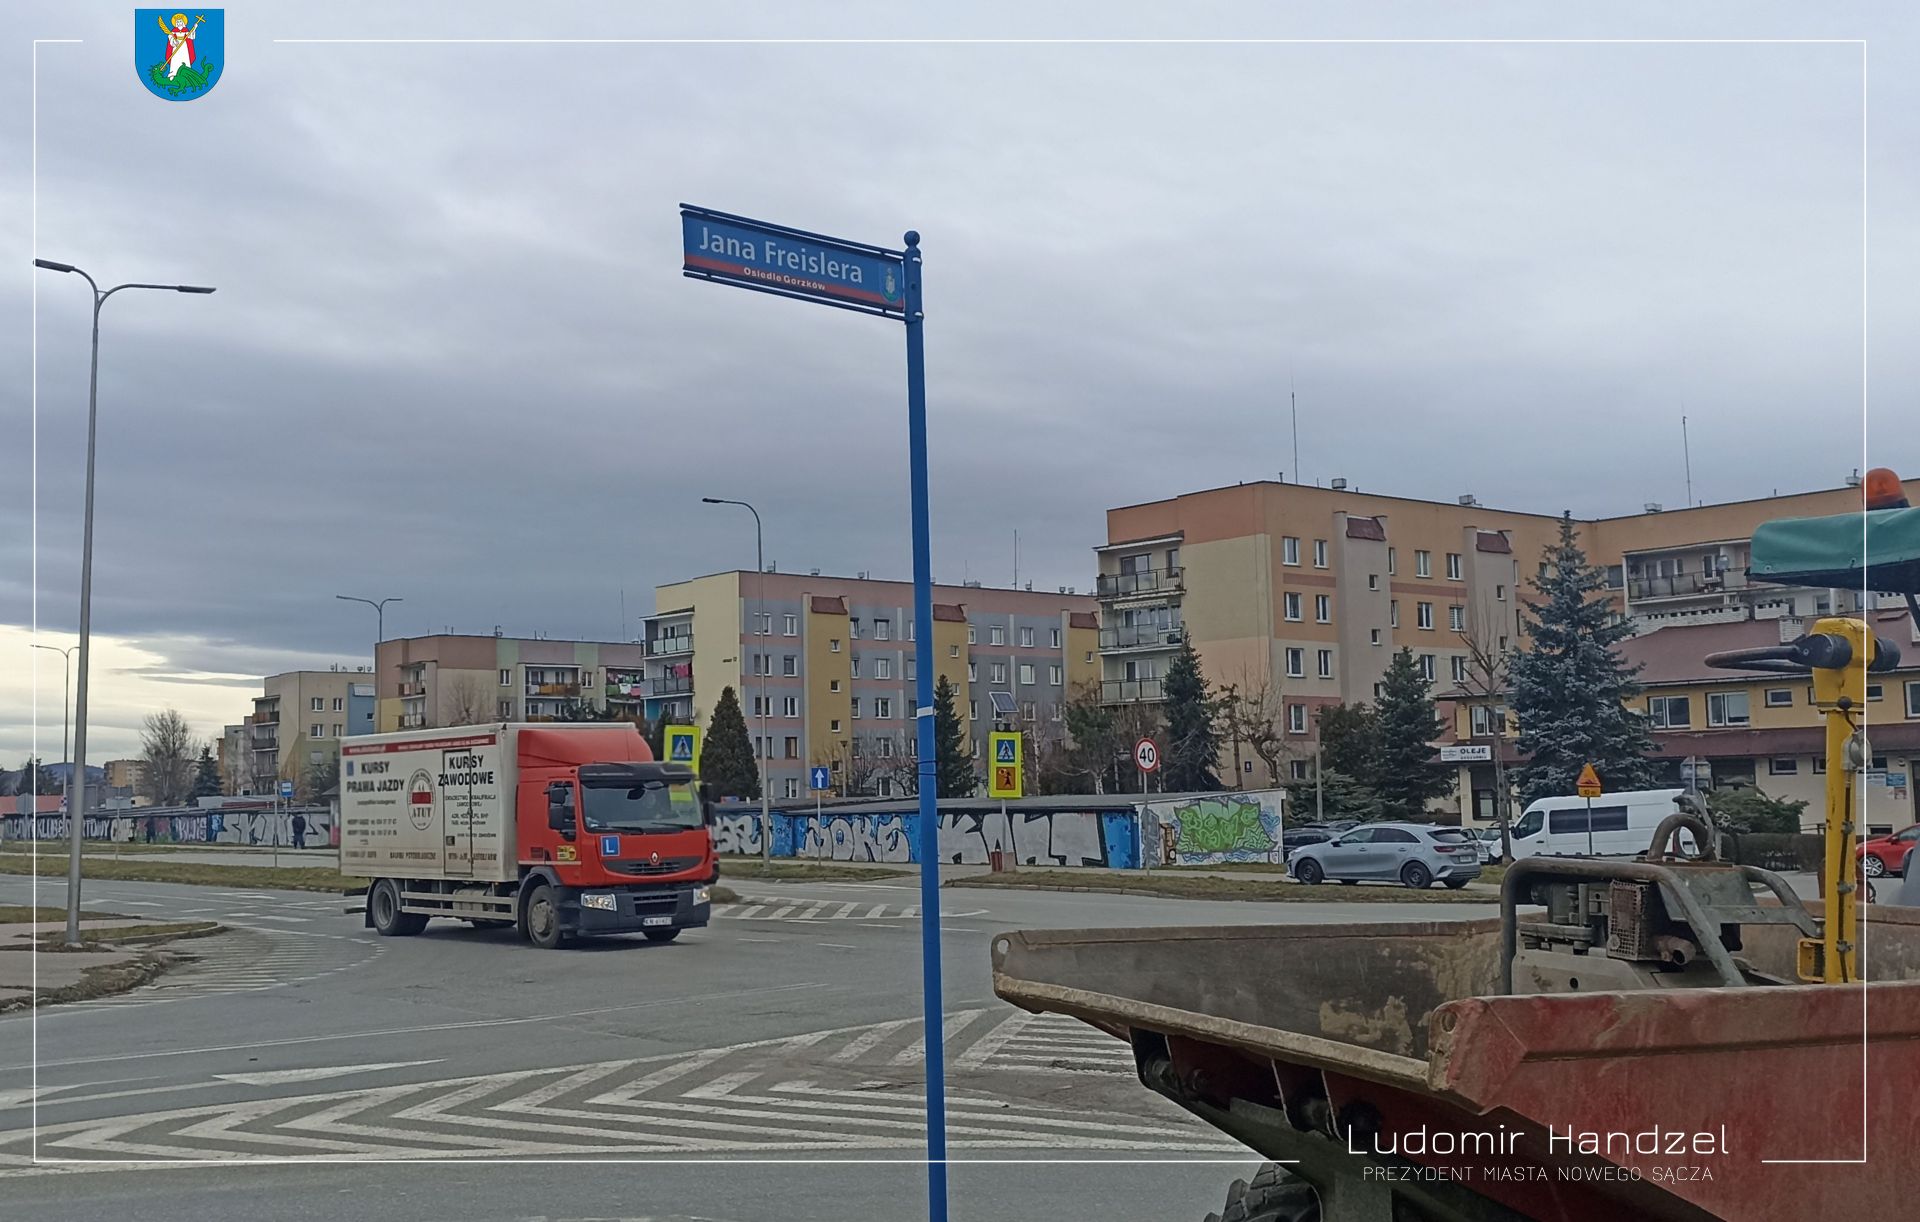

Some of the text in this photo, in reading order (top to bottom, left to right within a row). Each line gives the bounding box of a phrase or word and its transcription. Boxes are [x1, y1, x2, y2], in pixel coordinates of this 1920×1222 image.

[700, 227, 863, 283] Jana Freislera
[449, 755, 484, 769] KURSY
[1139, 747, 1155, 763] 40
[361, 761, 390, 774] KURSY
[347, 781, 375, 793] PRAWA
[377, 779, 405, 792] JAZDY
[438, 771, 494, 787] ZAWODOWE
[412, 807, 432, 818] ATUT
[605, 839, 615, 853] L
